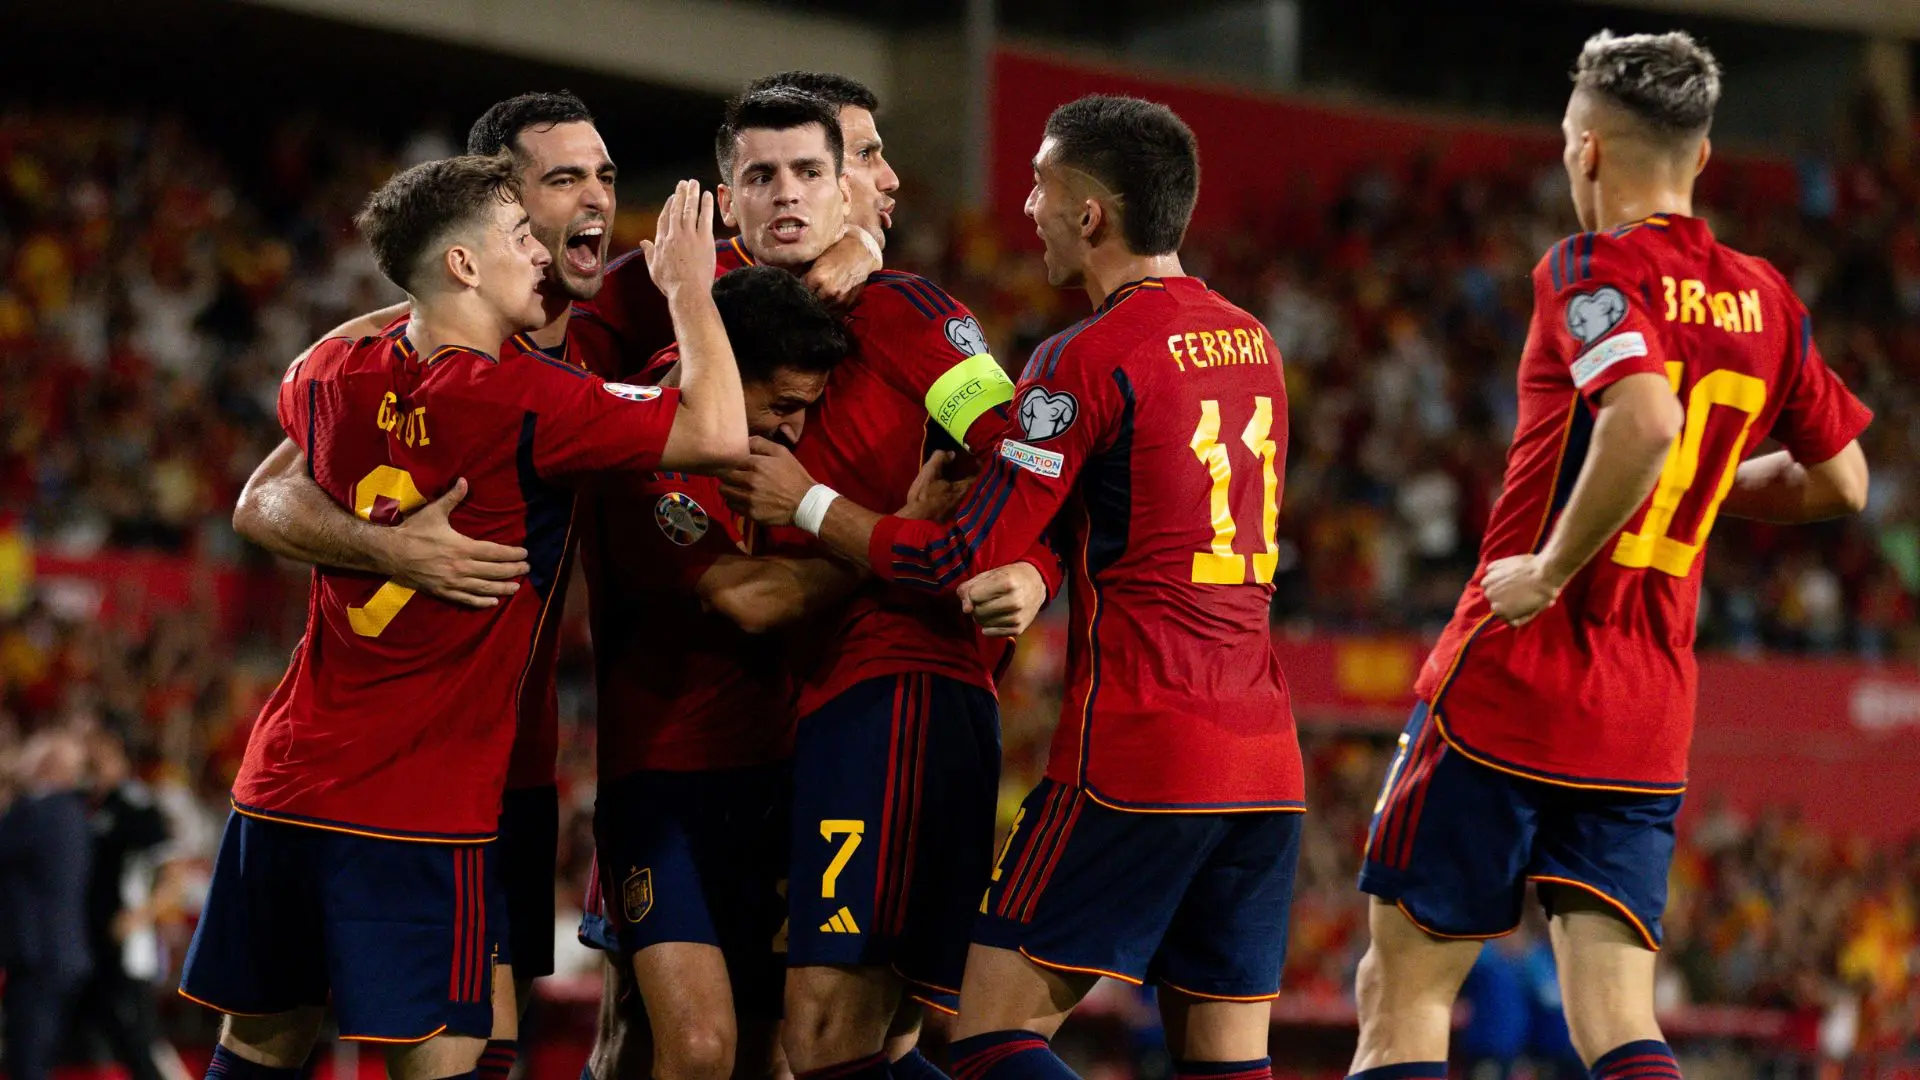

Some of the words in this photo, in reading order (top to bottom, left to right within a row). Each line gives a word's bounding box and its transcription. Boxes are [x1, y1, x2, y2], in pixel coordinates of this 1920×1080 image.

[1167, 327, 1269, 372] FERRAN
[940, 380, 983, 425] RESPECT
[1001, 446, 1061, 470] FOUNDATION
[1189, 396, 1279, 585] 11
[1610, 361, 1767, 578] 10
[346, 464, 429, 638] 9
[819, 819, 865, 898] 7
